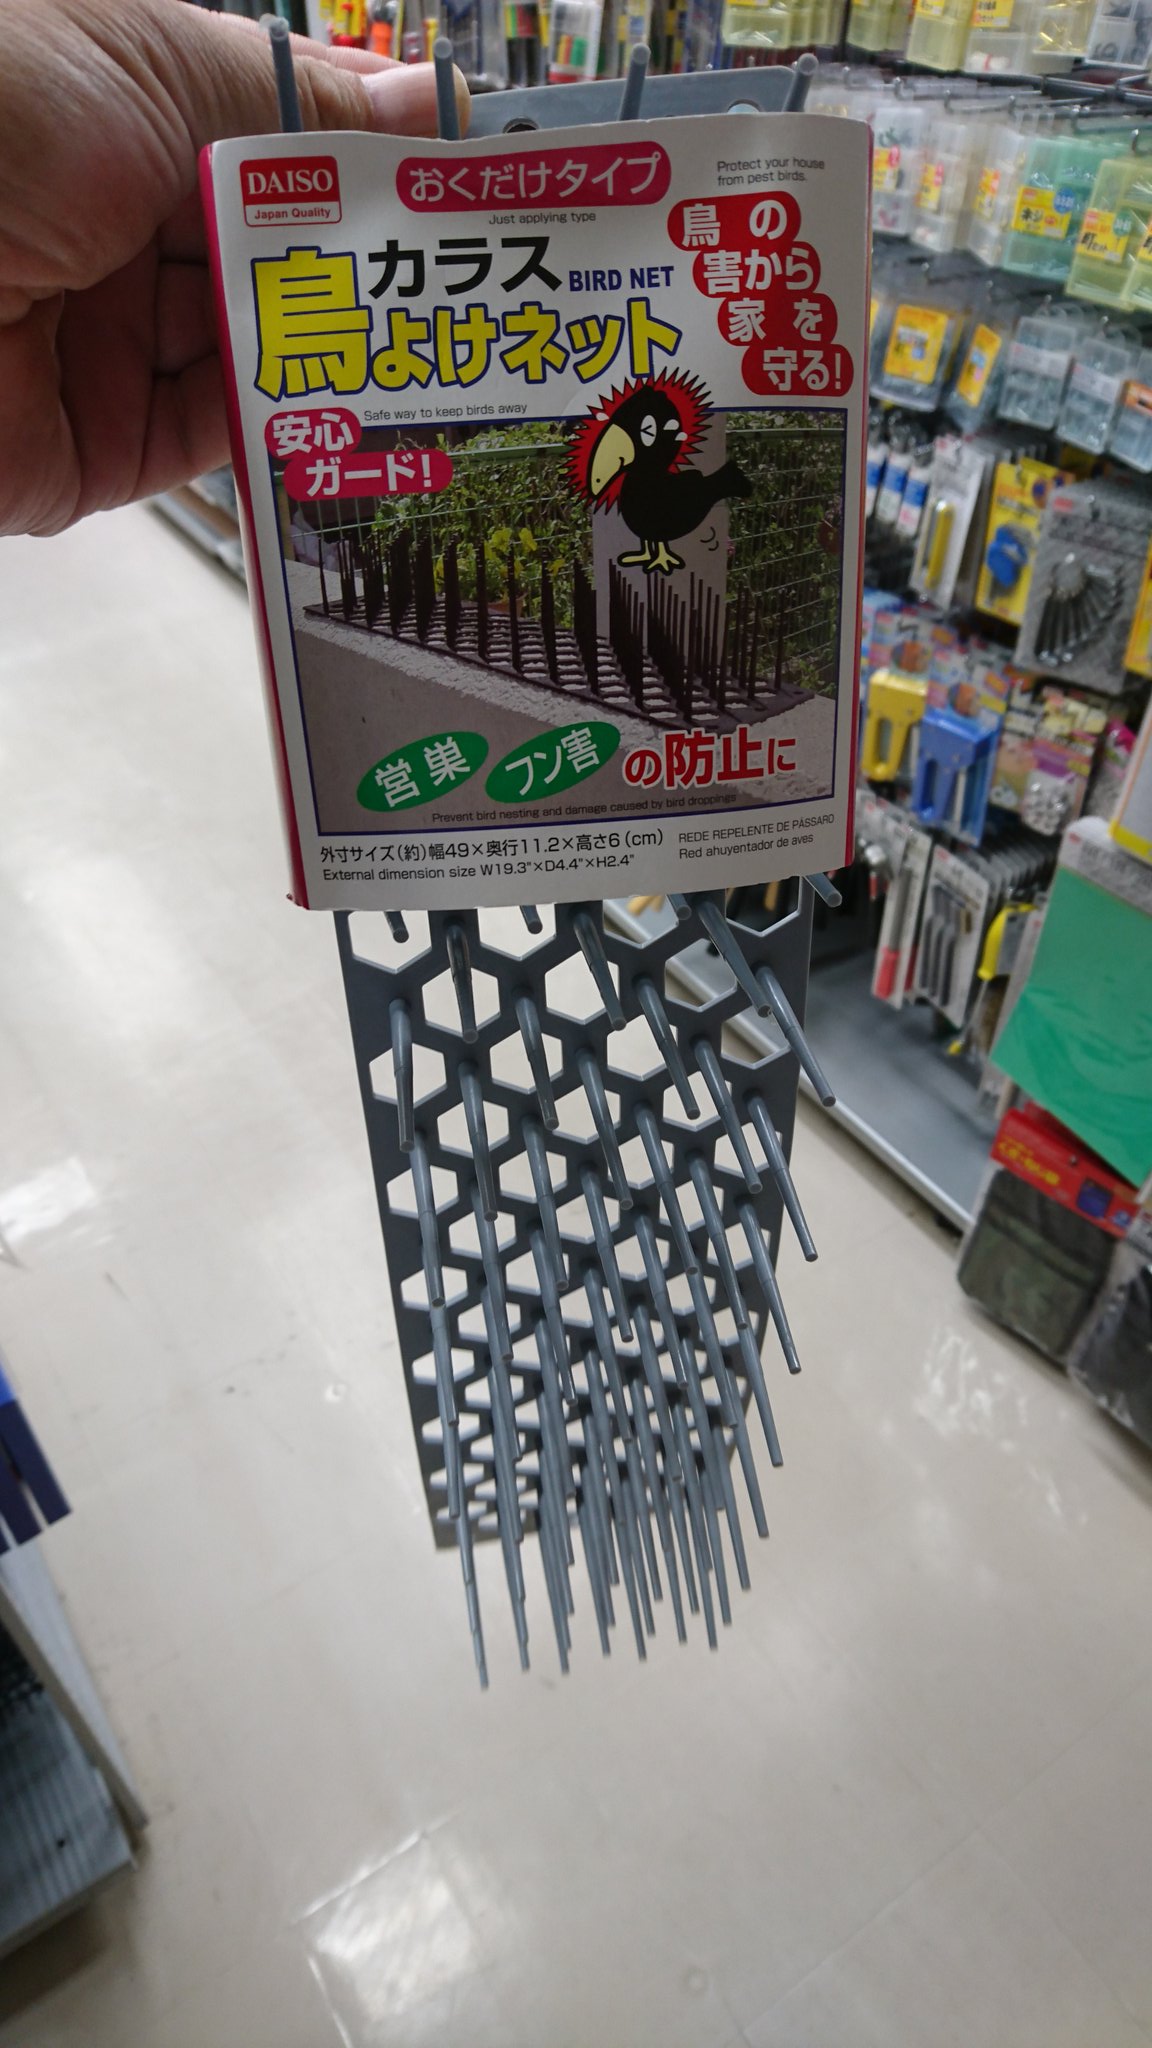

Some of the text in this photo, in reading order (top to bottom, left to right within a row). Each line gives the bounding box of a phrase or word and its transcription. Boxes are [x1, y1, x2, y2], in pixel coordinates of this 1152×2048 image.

[409, 151, 662, 203] おくだけタイプ
[717, 157, 825, 172] Protect your house
[718, 170, 807, 186] from pest birds.
[246, 168, 333, 195] DAISO
[254, 208, 331, 221] Japan Quality
[489, 212, 597, 225] Just applying type
[368, 236, 563, 300] カラス
[568, 265, 675, 292] BIRD NET
[703, 247, 814, 295] 害から
[250, 246, 683, 402] 鳥よけネット
[762, 347, 842, 392] 守る!
[364, 403, 528, 422] Safe way to keep birds away
[272, 411, 354, 457] 安心
[305, 452, 433, 498] ガード!
[374, 735, 471, 808] 営巣
[505, 726, 601, 796] フン害
[623, 726, 797, 789] の防止に
[432, 793, 737, 823] Prevent bird nesting and damage caused by bird droppings
[679, 831, 709, 843] REDE
[713, 823, 774, 840] REPELENTE
[776, 821, 790, 833] DE
[679, 834, 814, 860] Red ahuyentador de aves
[323, 868, 375, 881] External
[378, 866, 445, 880] dimension
[449, 865, 476, 878] size
